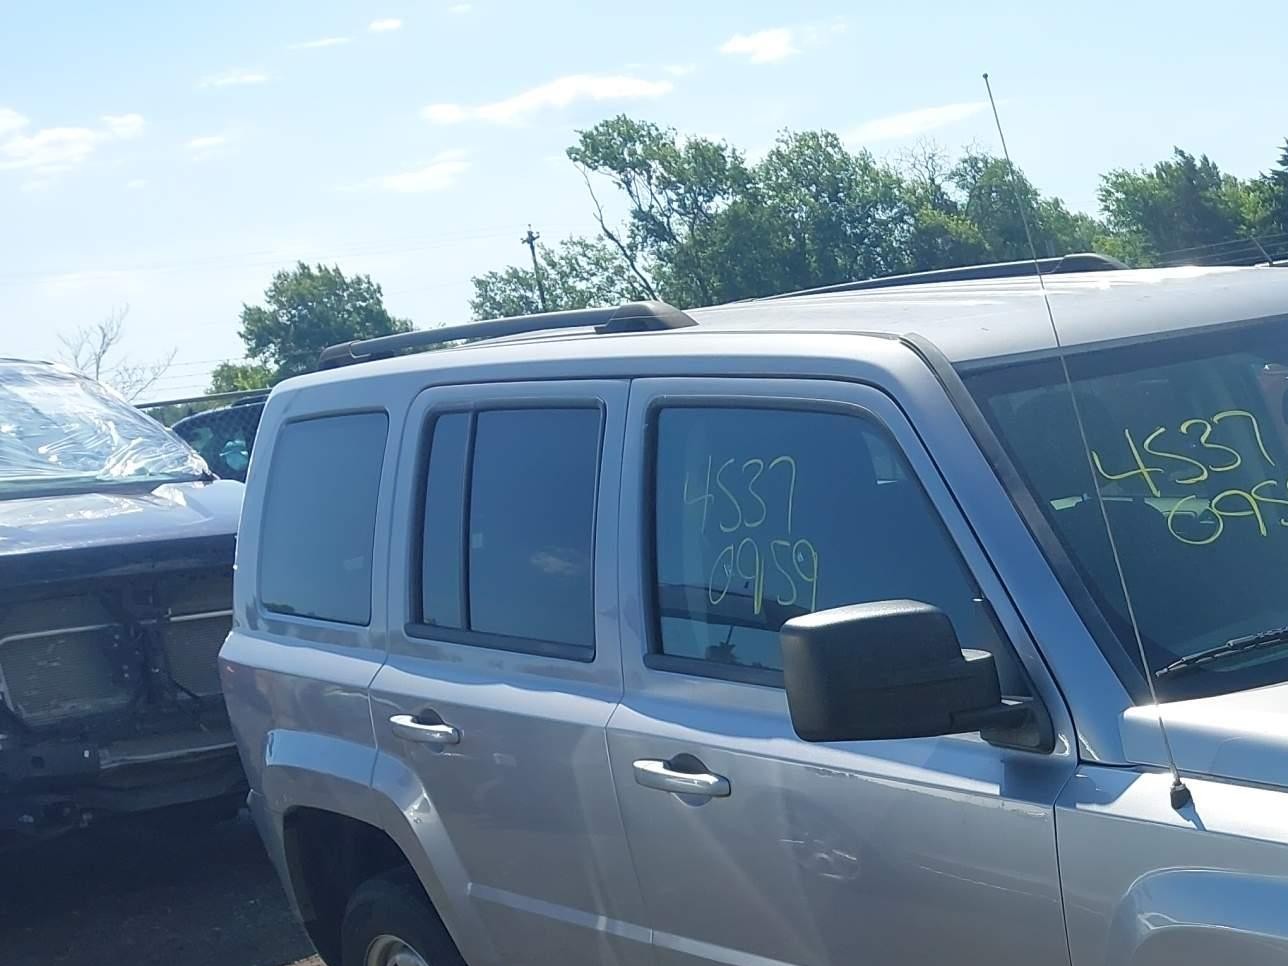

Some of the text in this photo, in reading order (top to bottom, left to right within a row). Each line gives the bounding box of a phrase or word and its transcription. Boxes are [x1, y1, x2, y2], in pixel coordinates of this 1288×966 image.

[1092, 410, 1275, 497] 4537
[684, 455, 797, 534] 4537
[709, 538, 818, 614] 0959
